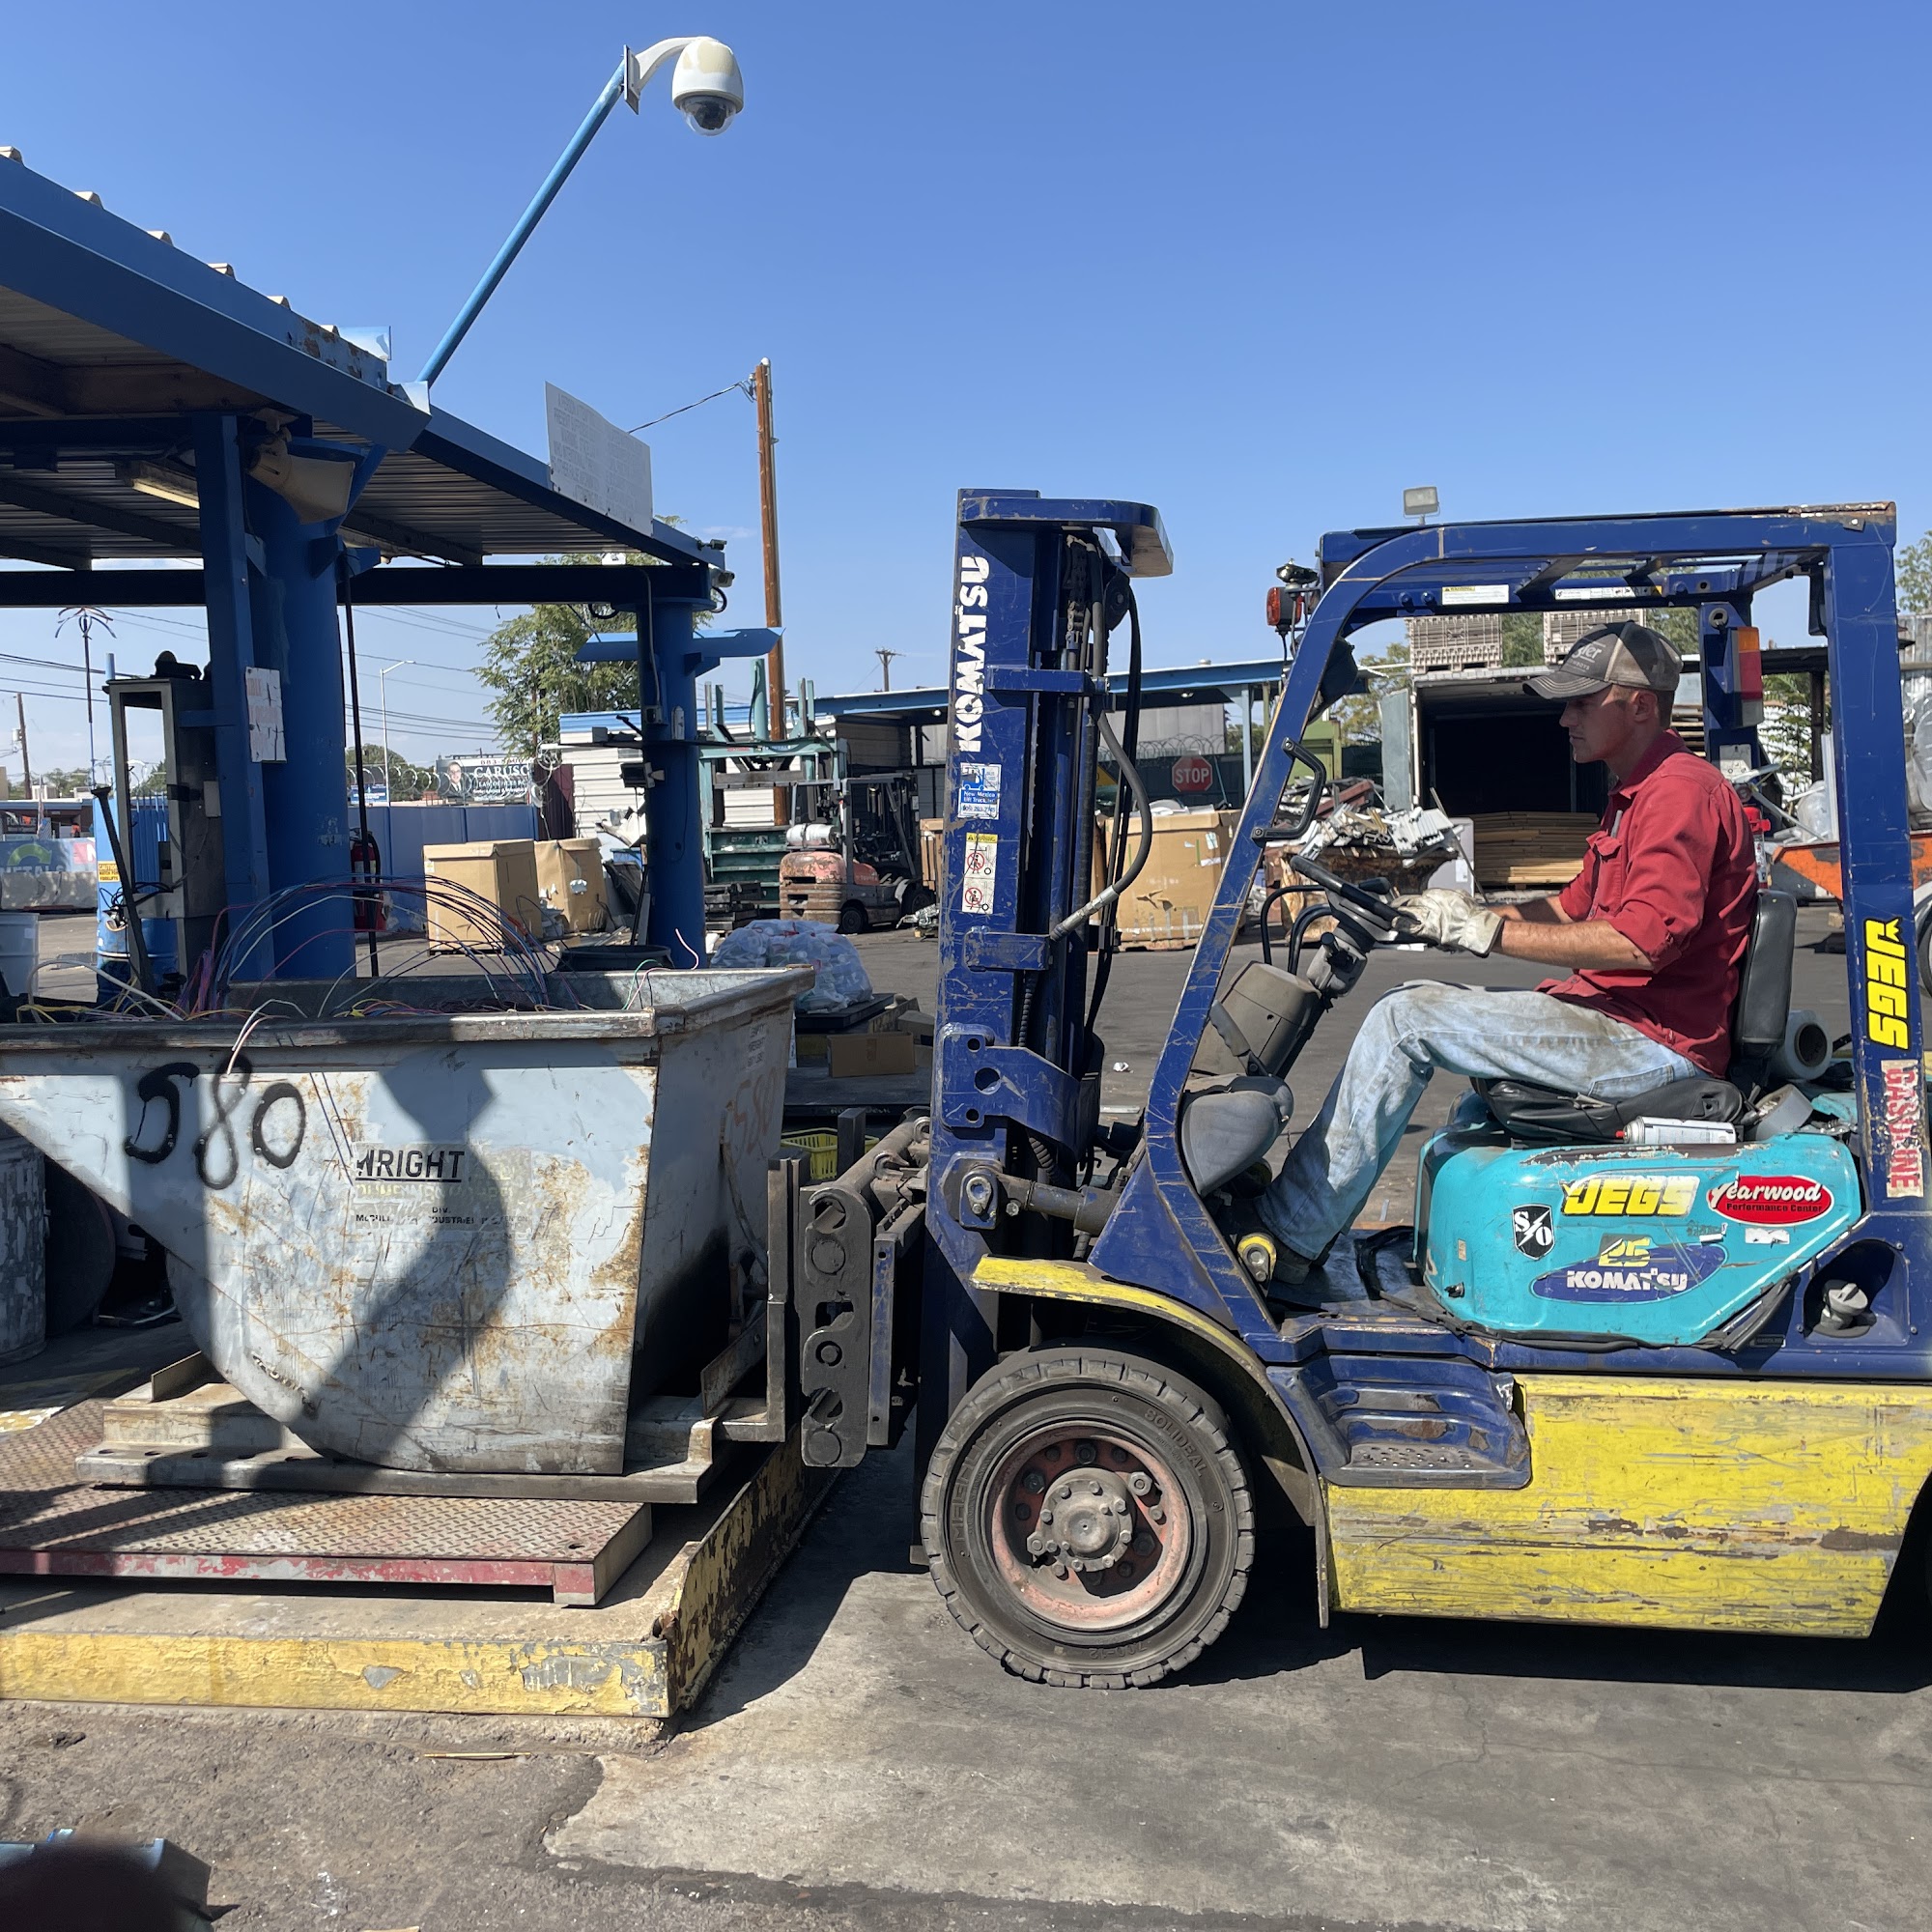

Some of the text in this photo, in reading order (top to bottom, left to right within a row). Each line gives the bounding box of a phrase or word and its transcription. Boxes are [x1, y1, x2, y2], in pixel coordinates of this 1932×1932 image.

[954, 555, 990, 753] KOMATSU
[1175, 767, 1209, 784] STOP
[1865, 918, 1910, 1052] JEGS
[124, 1049, 306, 1190] 580
[1561, 1176, 1700, 1217] JEGS
[1709, 1177, 1823, 1208] Yearwood
[1726, 1202, 1824, 1213] Performance Center
[1566, 1267, 1688, 1293] KOMATSU
[1144, 1408, 1208, 1478] SOLIDEAL
